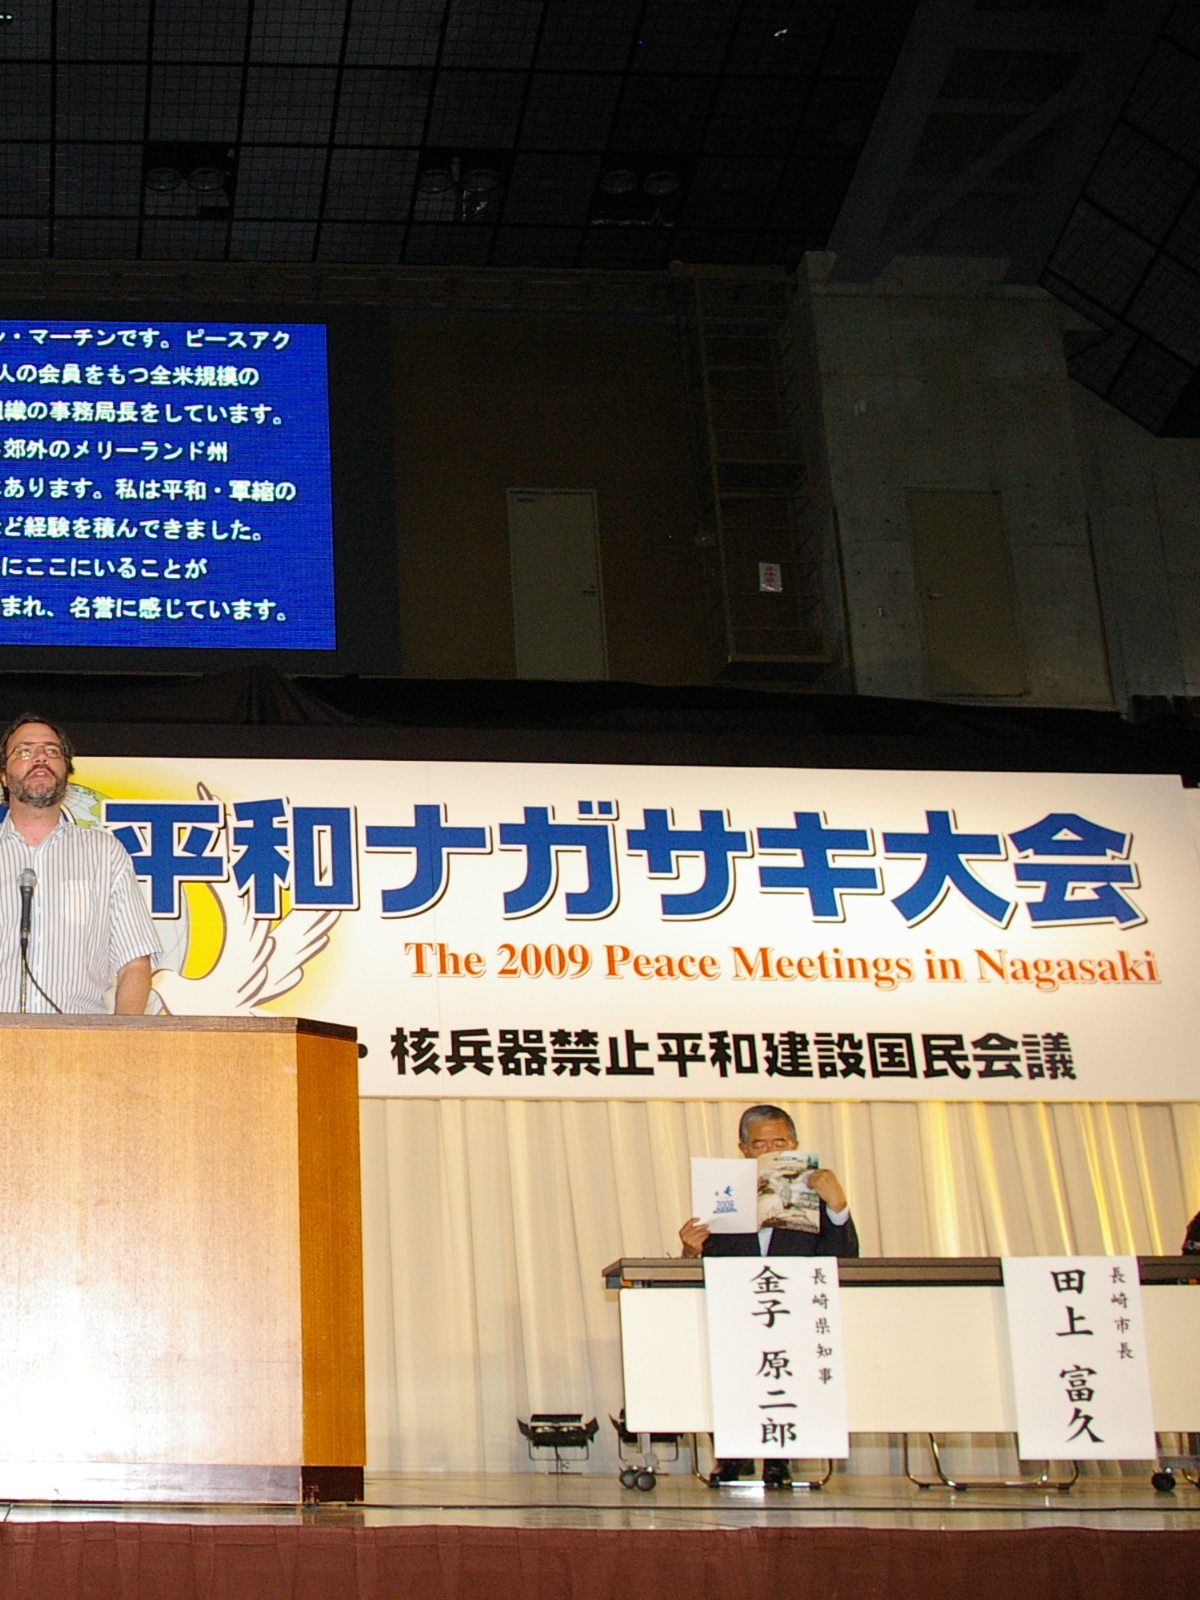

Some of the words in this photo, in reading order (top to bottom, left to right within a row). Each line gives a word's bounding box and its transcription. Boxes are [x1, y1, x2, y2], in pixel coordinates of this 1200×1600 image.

[404, 942, 487, 978] The
[496, 943, 593, 979] 2009
[602, 944, 722, 981] Peace
[730, 945, 915, 991] Meetings
[924, 948, 967, 984] in
[973, 949, 1161, 993] Nagasaki
[811, 1267, 833, 1384] 長崎県知事
[1109, 1266, 1134, 1360] 長崎市長
